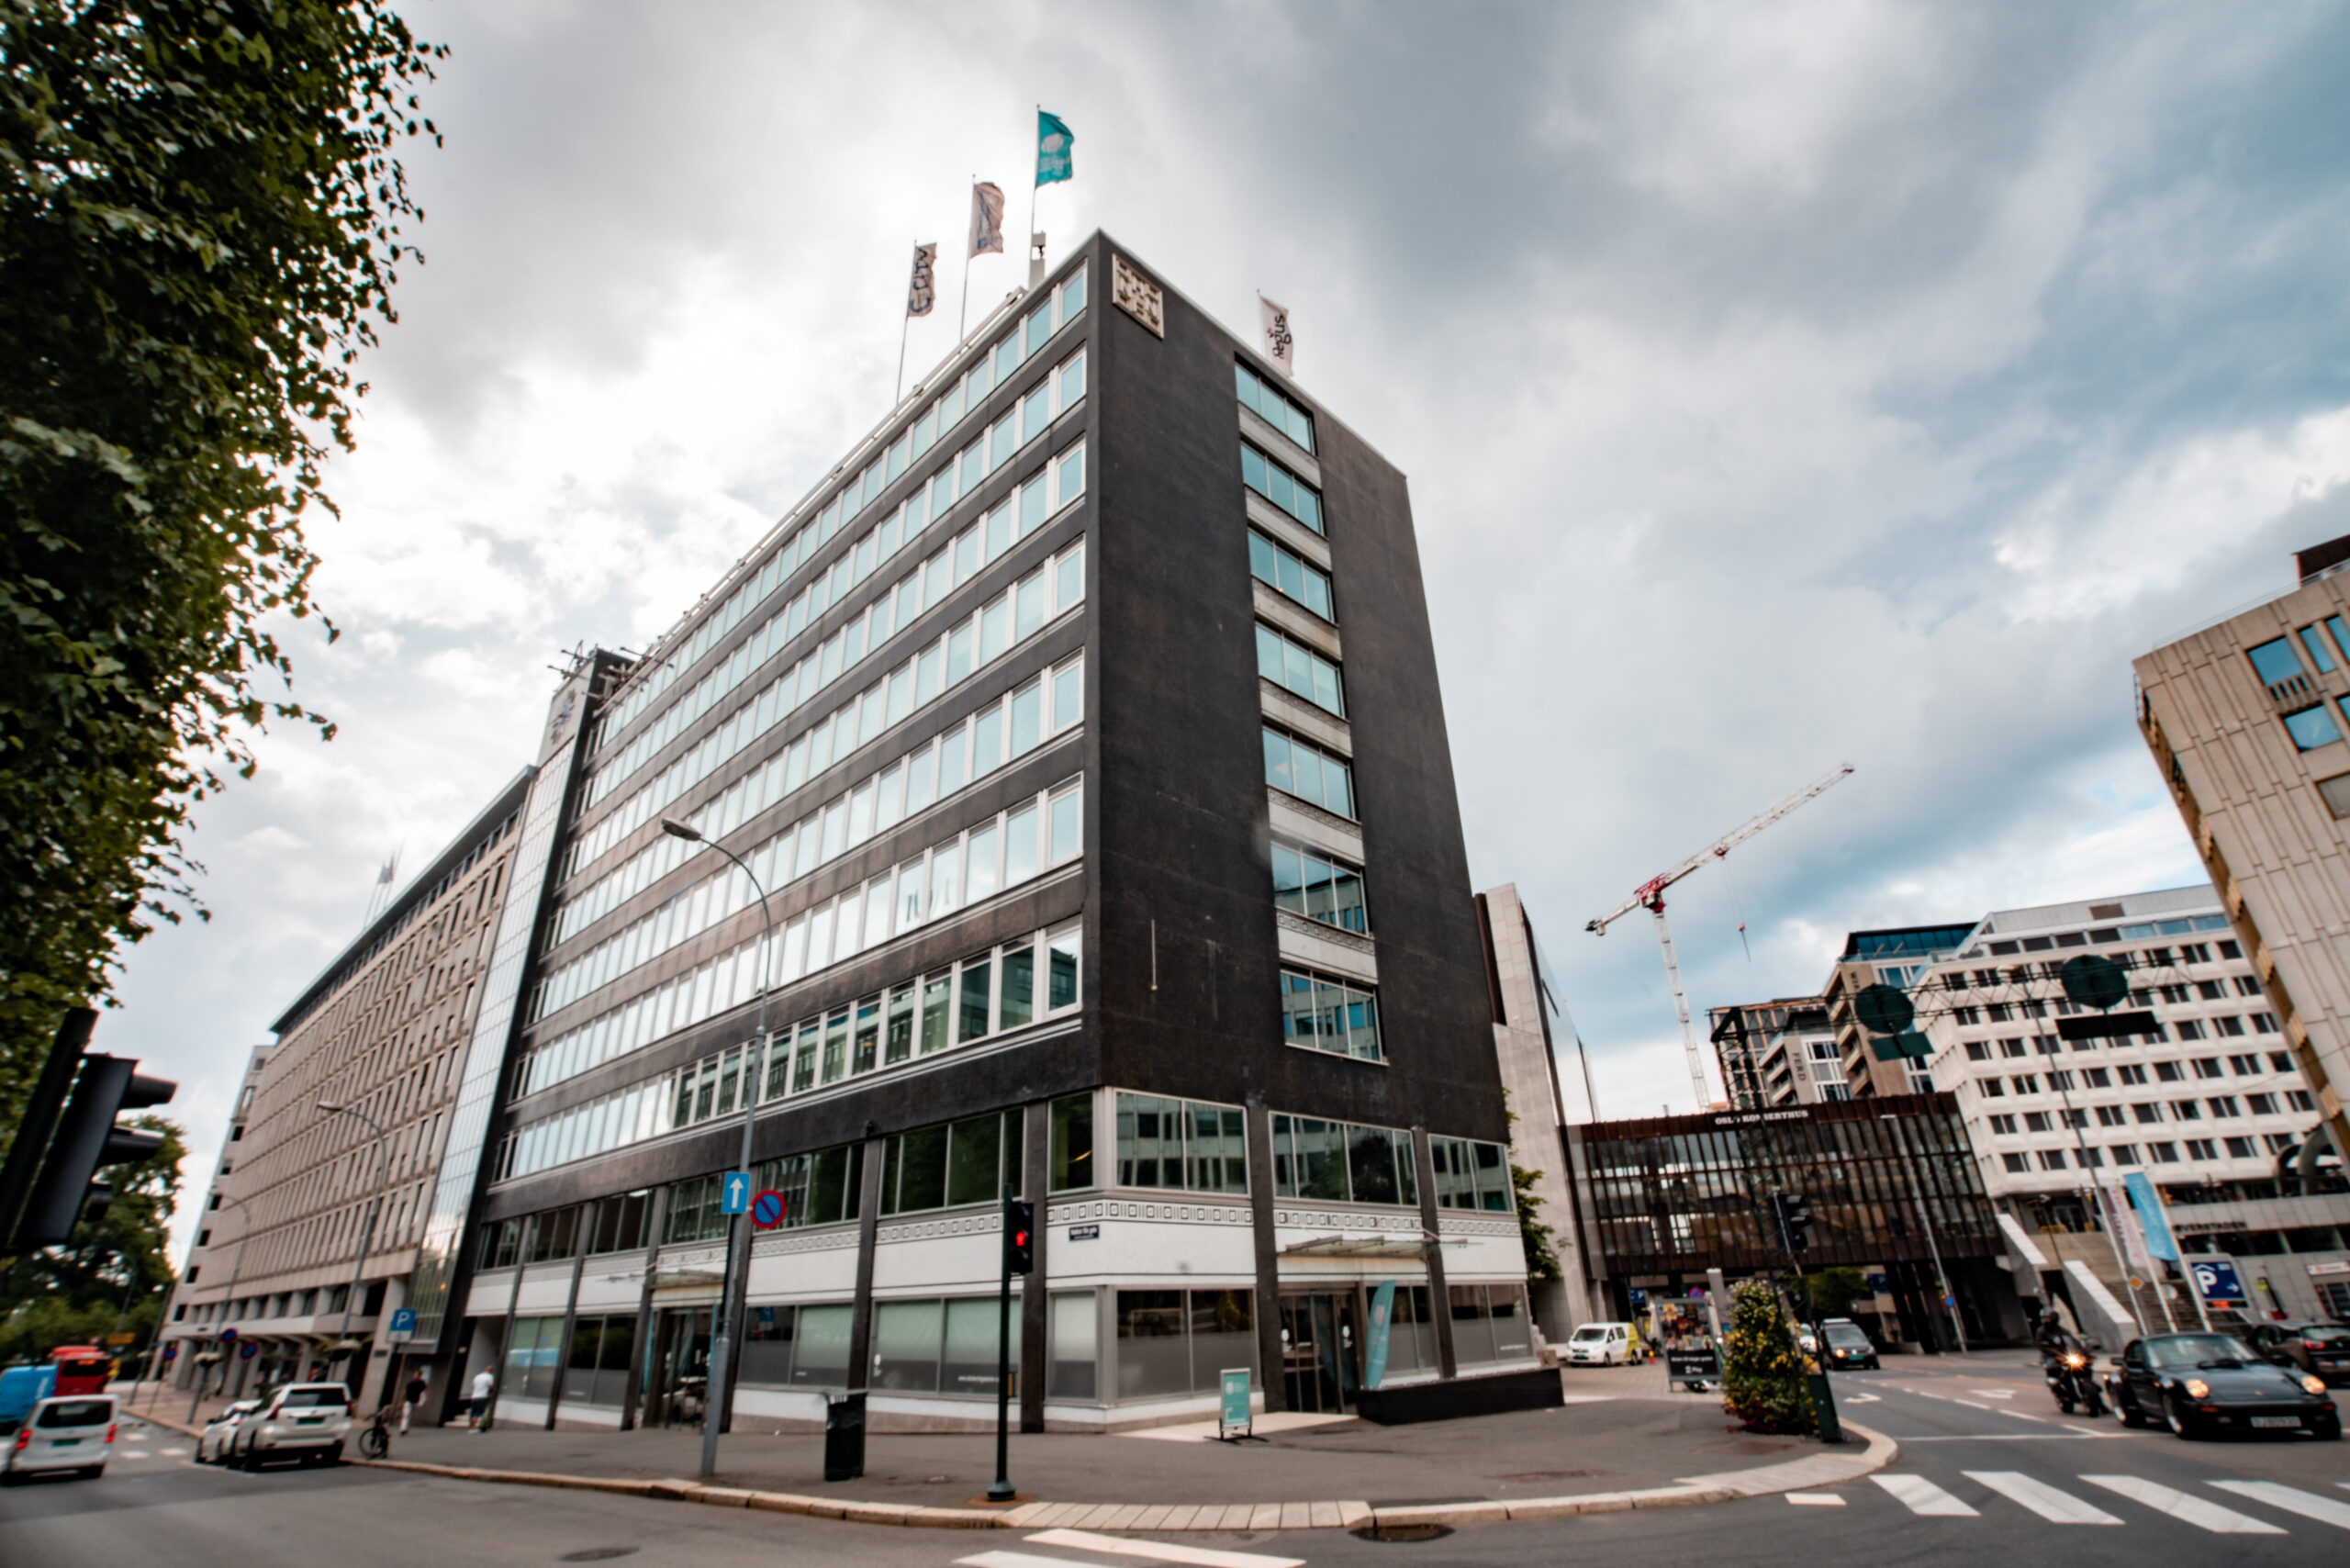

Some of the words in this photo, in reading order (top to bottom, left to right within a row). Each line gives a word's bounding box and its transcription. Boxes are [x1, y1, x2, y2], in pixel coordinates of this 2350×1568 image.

[1792, 1051, 1807, 1081] FERD
[2196, 1271, 2218, 1294] P
[397, 1311, 410, 1327] P
